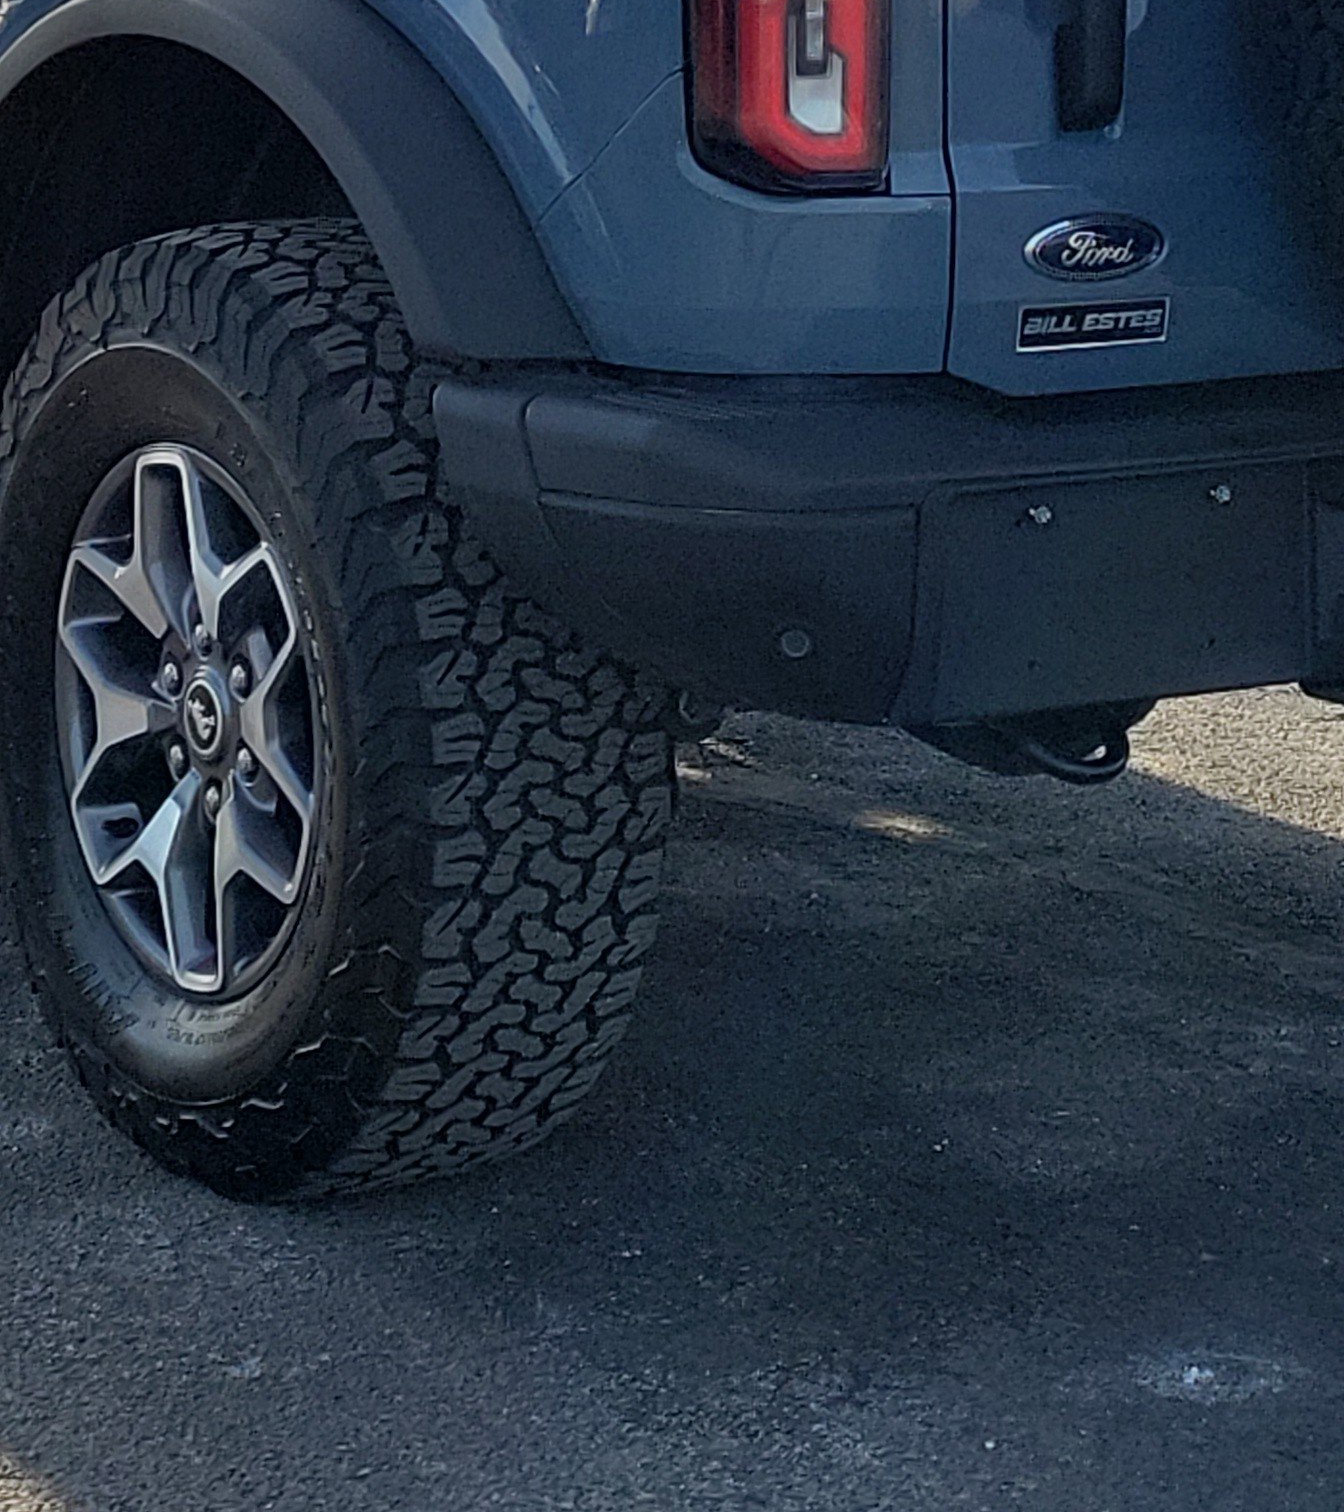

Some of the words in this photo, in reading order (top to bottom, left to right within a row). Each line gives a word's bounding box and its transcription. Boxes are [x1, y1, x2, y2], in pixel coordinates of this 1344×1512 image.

[1060, 230, 1134, 267] Ford
[1023, 315, 1078, 336] BILL
[1081, 308, 1164, 332] ESTES
